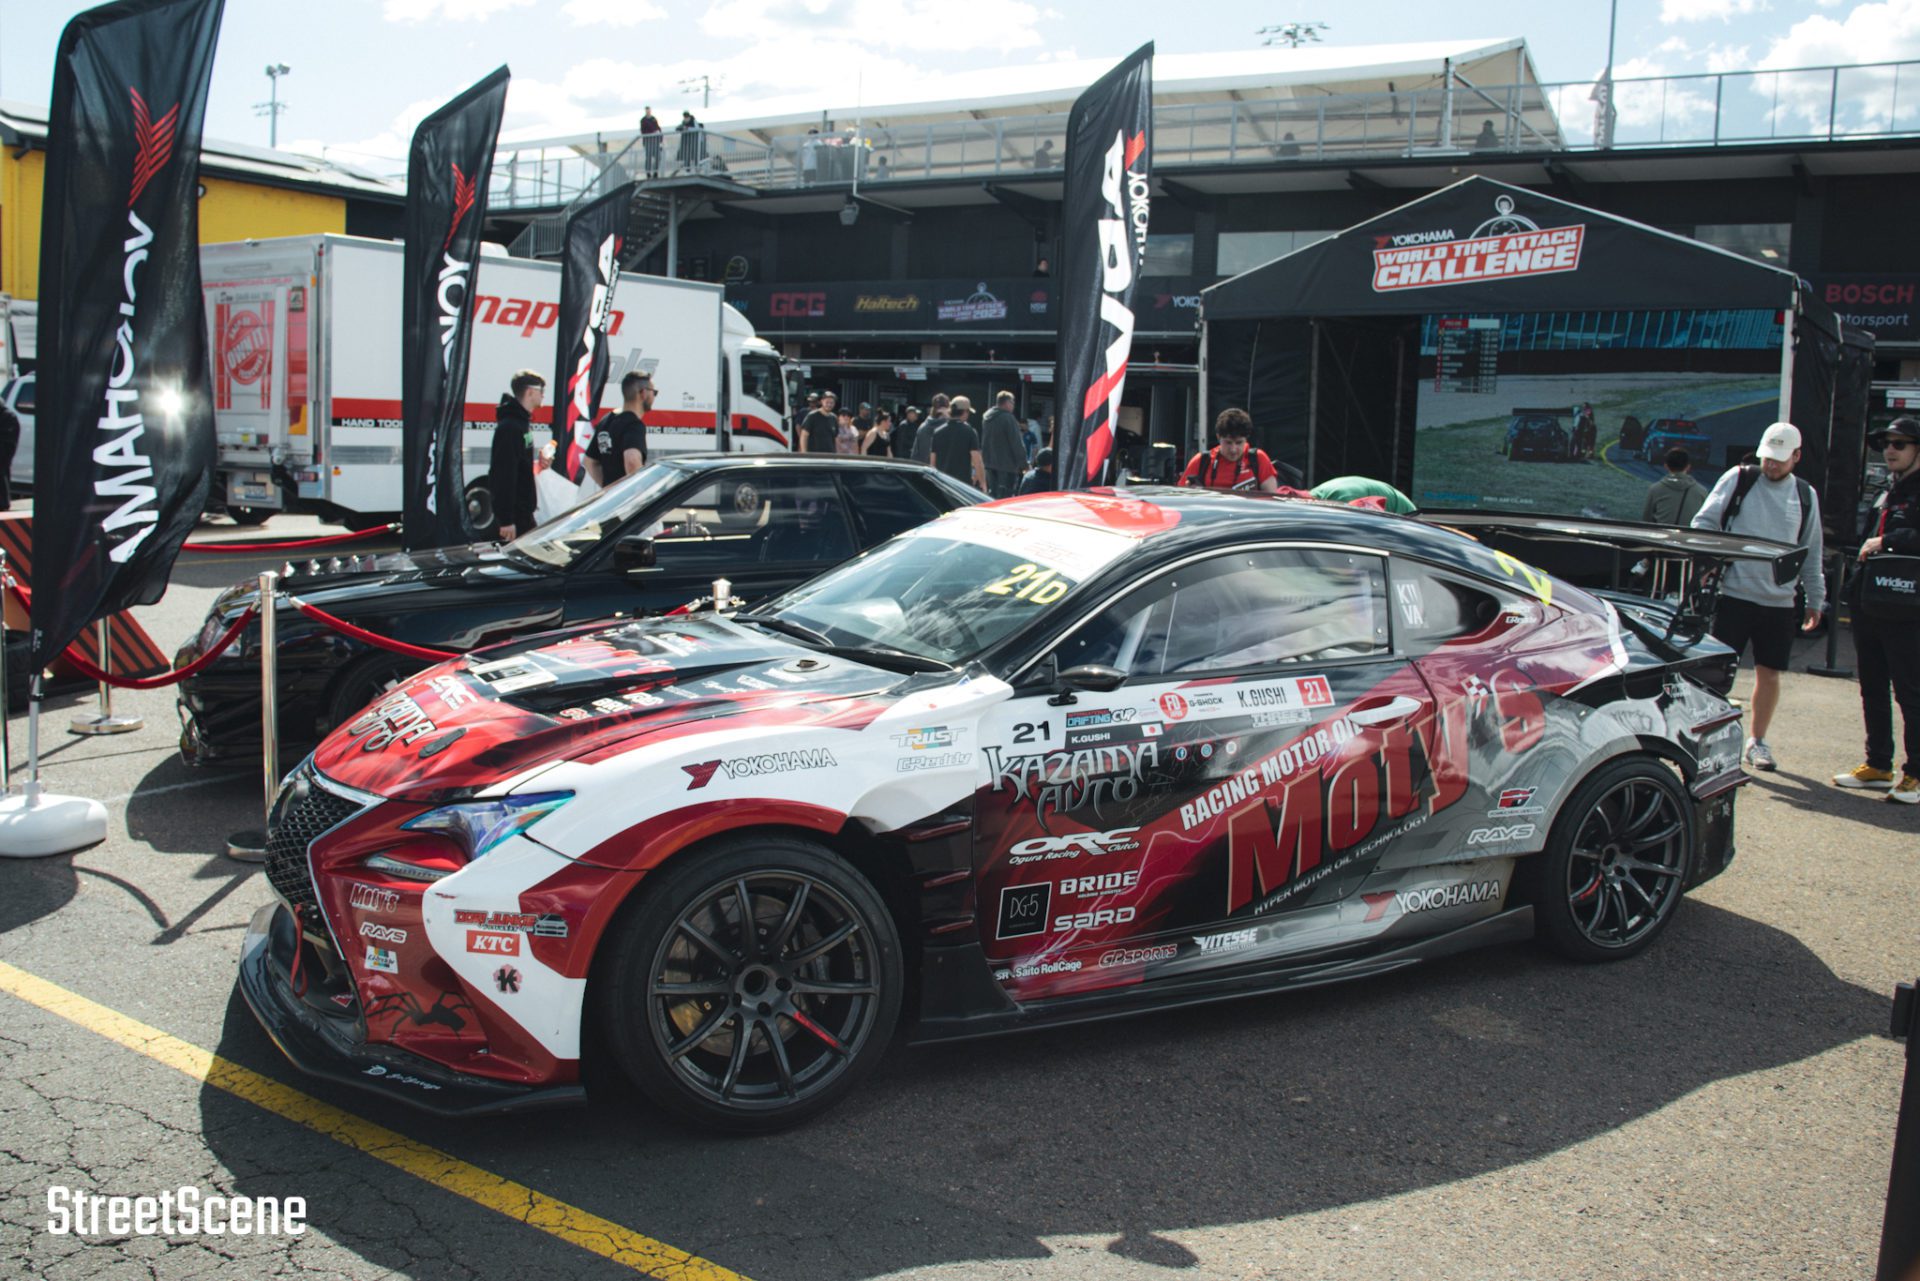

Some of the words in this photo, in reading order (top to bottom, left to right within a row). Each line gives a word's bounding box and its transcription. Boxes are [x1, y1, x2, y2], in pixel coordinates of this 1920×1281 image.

[1379, 246, 1448, 267] WORLD
[1453, 240, 1501, 258] TIME
[1505, 228, 1578, 252] ATTACK
[1392, 229, 1455, 247] YOKOHAMA
[1377, 244, 1578, 288] CHALLENGE
[771, 292, 826, 317] GCG
[854, 294, 920, 313] Haltech
[1172, 296, 1201, 308] YOKO
[1825, 284, 1914, 304] BOSCH
[1841, 312, 1909, 327] torsport
[341, 418, 376, 428] HAND
[377, 419, 403, 429] TOO
[475, 421, 498, 430] TOO
[1875, 576, 1915, 589] Viridian
[1236, 686, 1288, 708] K.GUSHI
[1303, 680, 1326, 703] 21
[1067, 713, 1111, 727] DRIFTING
[1112, 707, 1137, 723] CUP
[890, 726, 968, 749] TRUST
[1012, 720, 1051, 744] 21
[1071, 732, 1111, 744] K.GUSHI
[720, 748, 838, 780] YOKOHAMA
[897, 752, 972, 772] GReddy
[981, 741, 1160, 804] KAZAMA
[1178, 769, 1257, 831] RACING
[1260, 733, 1332, 788] MOTOR
[1331, 715, 1364, 745] OIL
[1036, 775, 1138, 831] AUTO
[1009, 826, 1141, 856] ORC
[1467, 823, 1536, 845] RAYS
[1008, 855, 1042, 866] Ogura
[1044, 849, 1080, 861] Racing
[1107, 841, 1140, 853] Clutch
[1254, 890, 1292, 915] HYPER
[1293, 867, 1333, 894] MOTOR
[1334, 857, 1353, 871] OIL
[1355, 813, 1429, 858] TECHNOLOGY
[1059, 870, 1139, 896] BRIDE
[1395, 881, 1501, 915] YOKOHAMA
[359, 921, 407, 944] RAYS
[472, 934, 514, 952] KTC
[1193, 927, 1259, 950] VITESSE
[497, 967, 519, 994] K
[1016, 967, 1040, 978] Saito
[1041, 960, 1082, 975] RollCage
